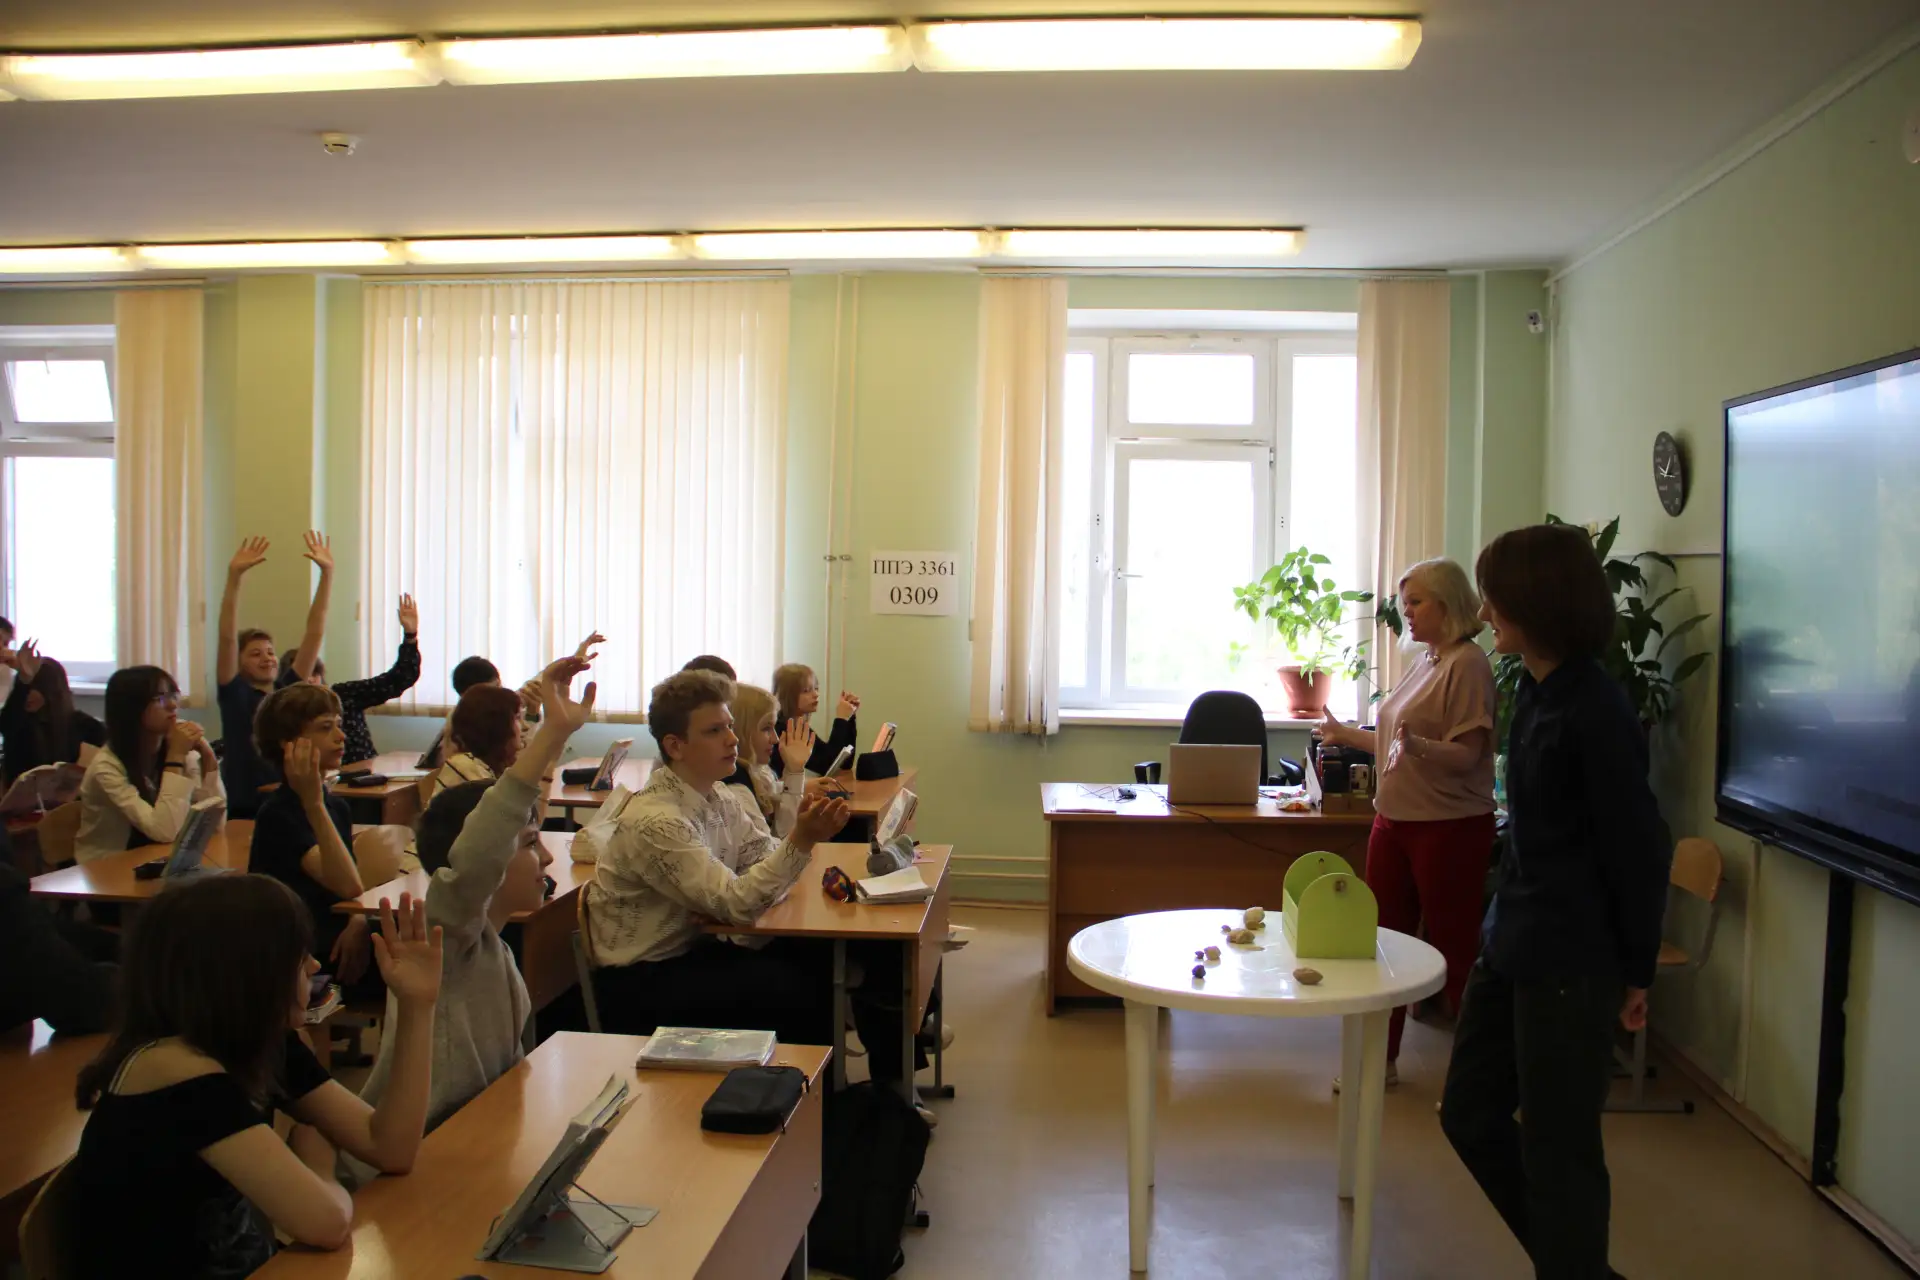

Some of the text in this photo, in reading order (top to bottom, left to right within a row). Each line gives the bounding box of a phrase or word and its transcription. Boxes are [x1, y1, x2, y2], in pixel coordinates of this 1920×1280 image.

[873, 560, 955, 576] ППЭ 3361
[890, 586, 938, 605] 0309
